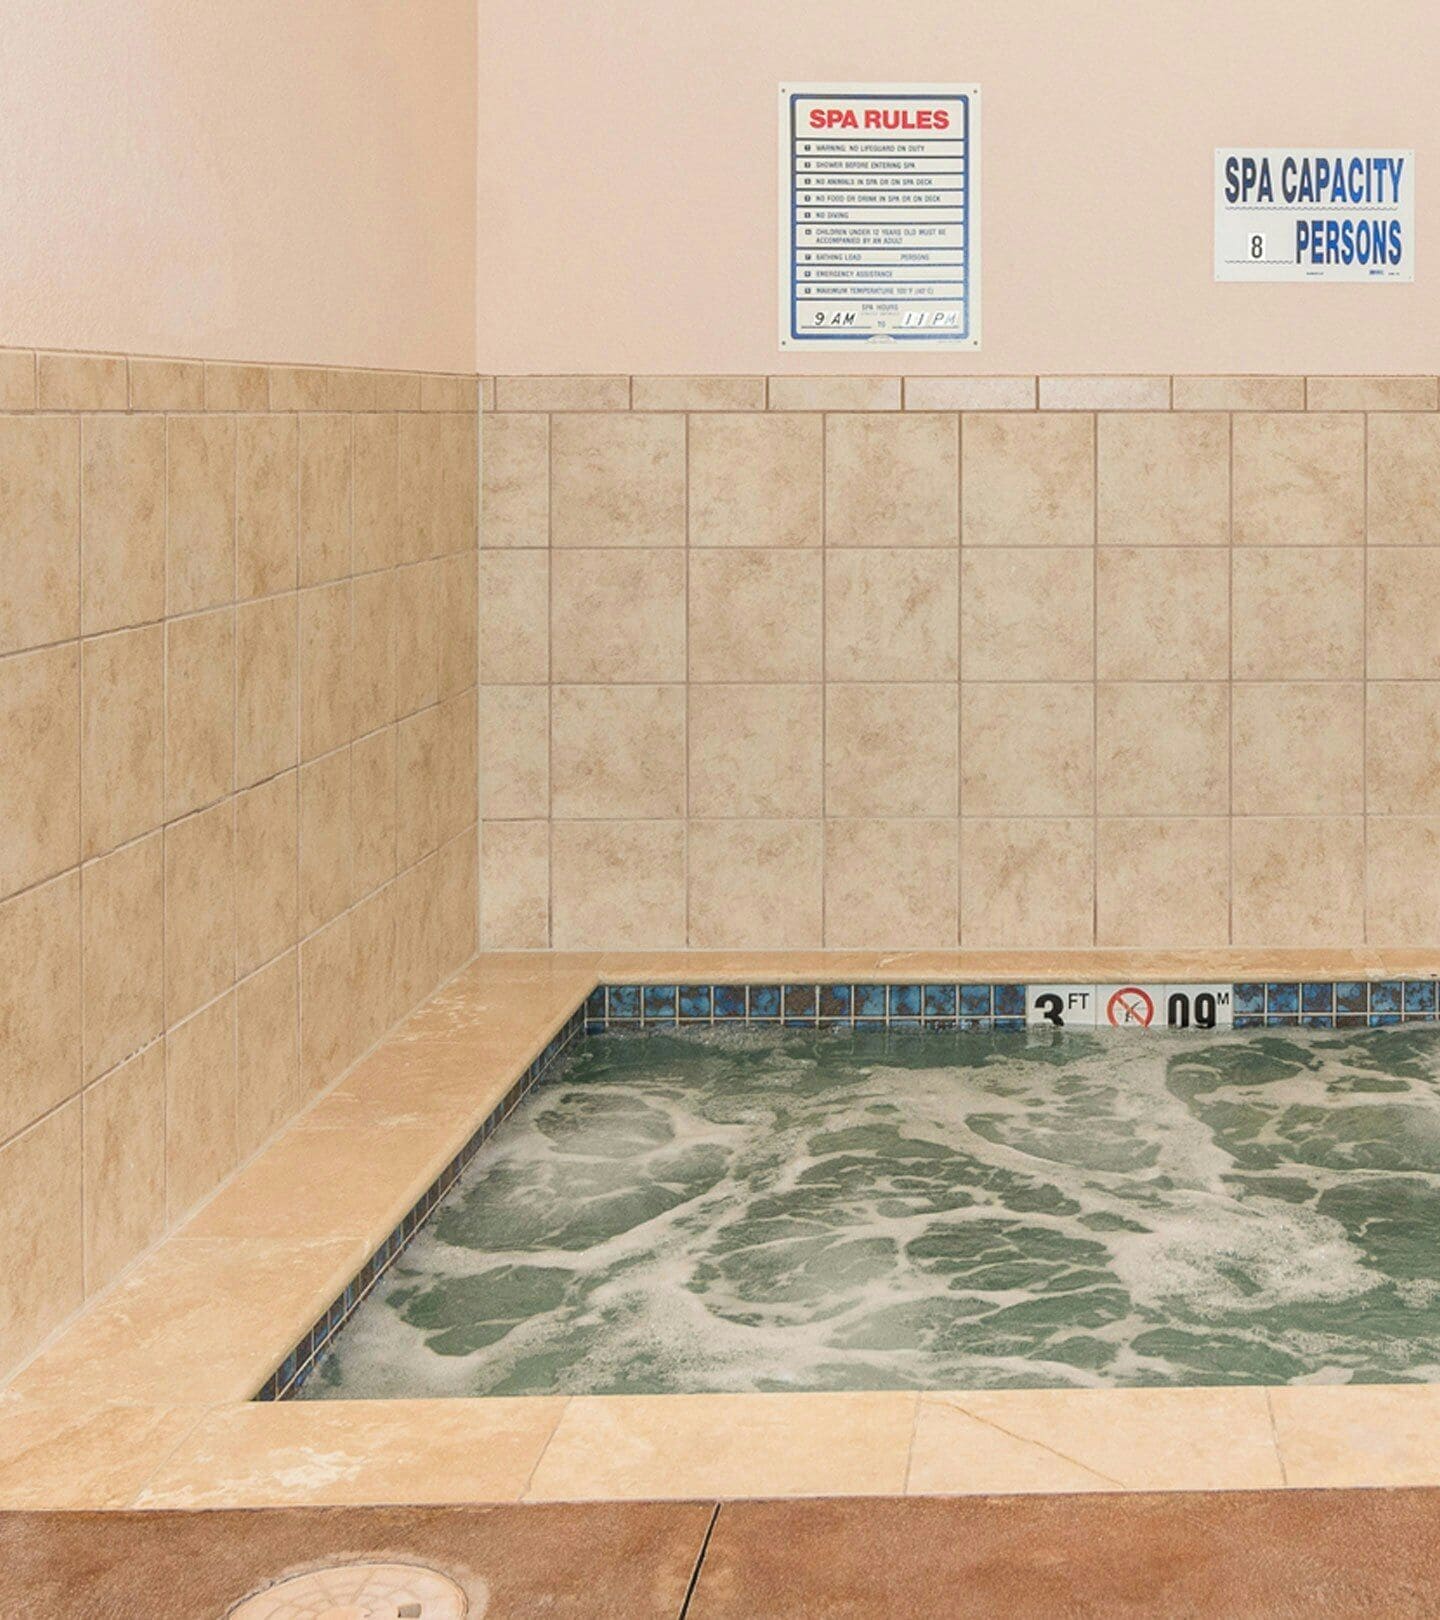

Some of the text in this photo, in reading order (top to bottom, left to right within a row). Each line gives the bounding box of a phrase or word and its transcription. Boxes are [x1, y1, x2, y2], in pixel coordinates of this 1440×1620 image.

[809, 109, 949, 129] SPA RULES
[849, 144, 859, 152] NO
[860, 144, 895, 152] LIFEGUARD
[897, 144, 906, 152] ON
[909, 144, 925, 152] DUTY
[816, 161, 843, 169] SHOWER
[871, 161, 901, 169] ENTERING
[1224, 156, 1404, 204] SPA CAPACITY
[827, 211, 849, 219] DIVING
[1251, 219, 1401, 265] 8 PERSONS
[816, 270, 854, 278] EMERGENCY
[814, 312, 825, 326] 9
[831, 312, 856, 326] AM
[1034, 993, 1065, 1027] 3
[1068, 993, 1089, 1009] FT
[1217, 992, 1230, 1005] M
